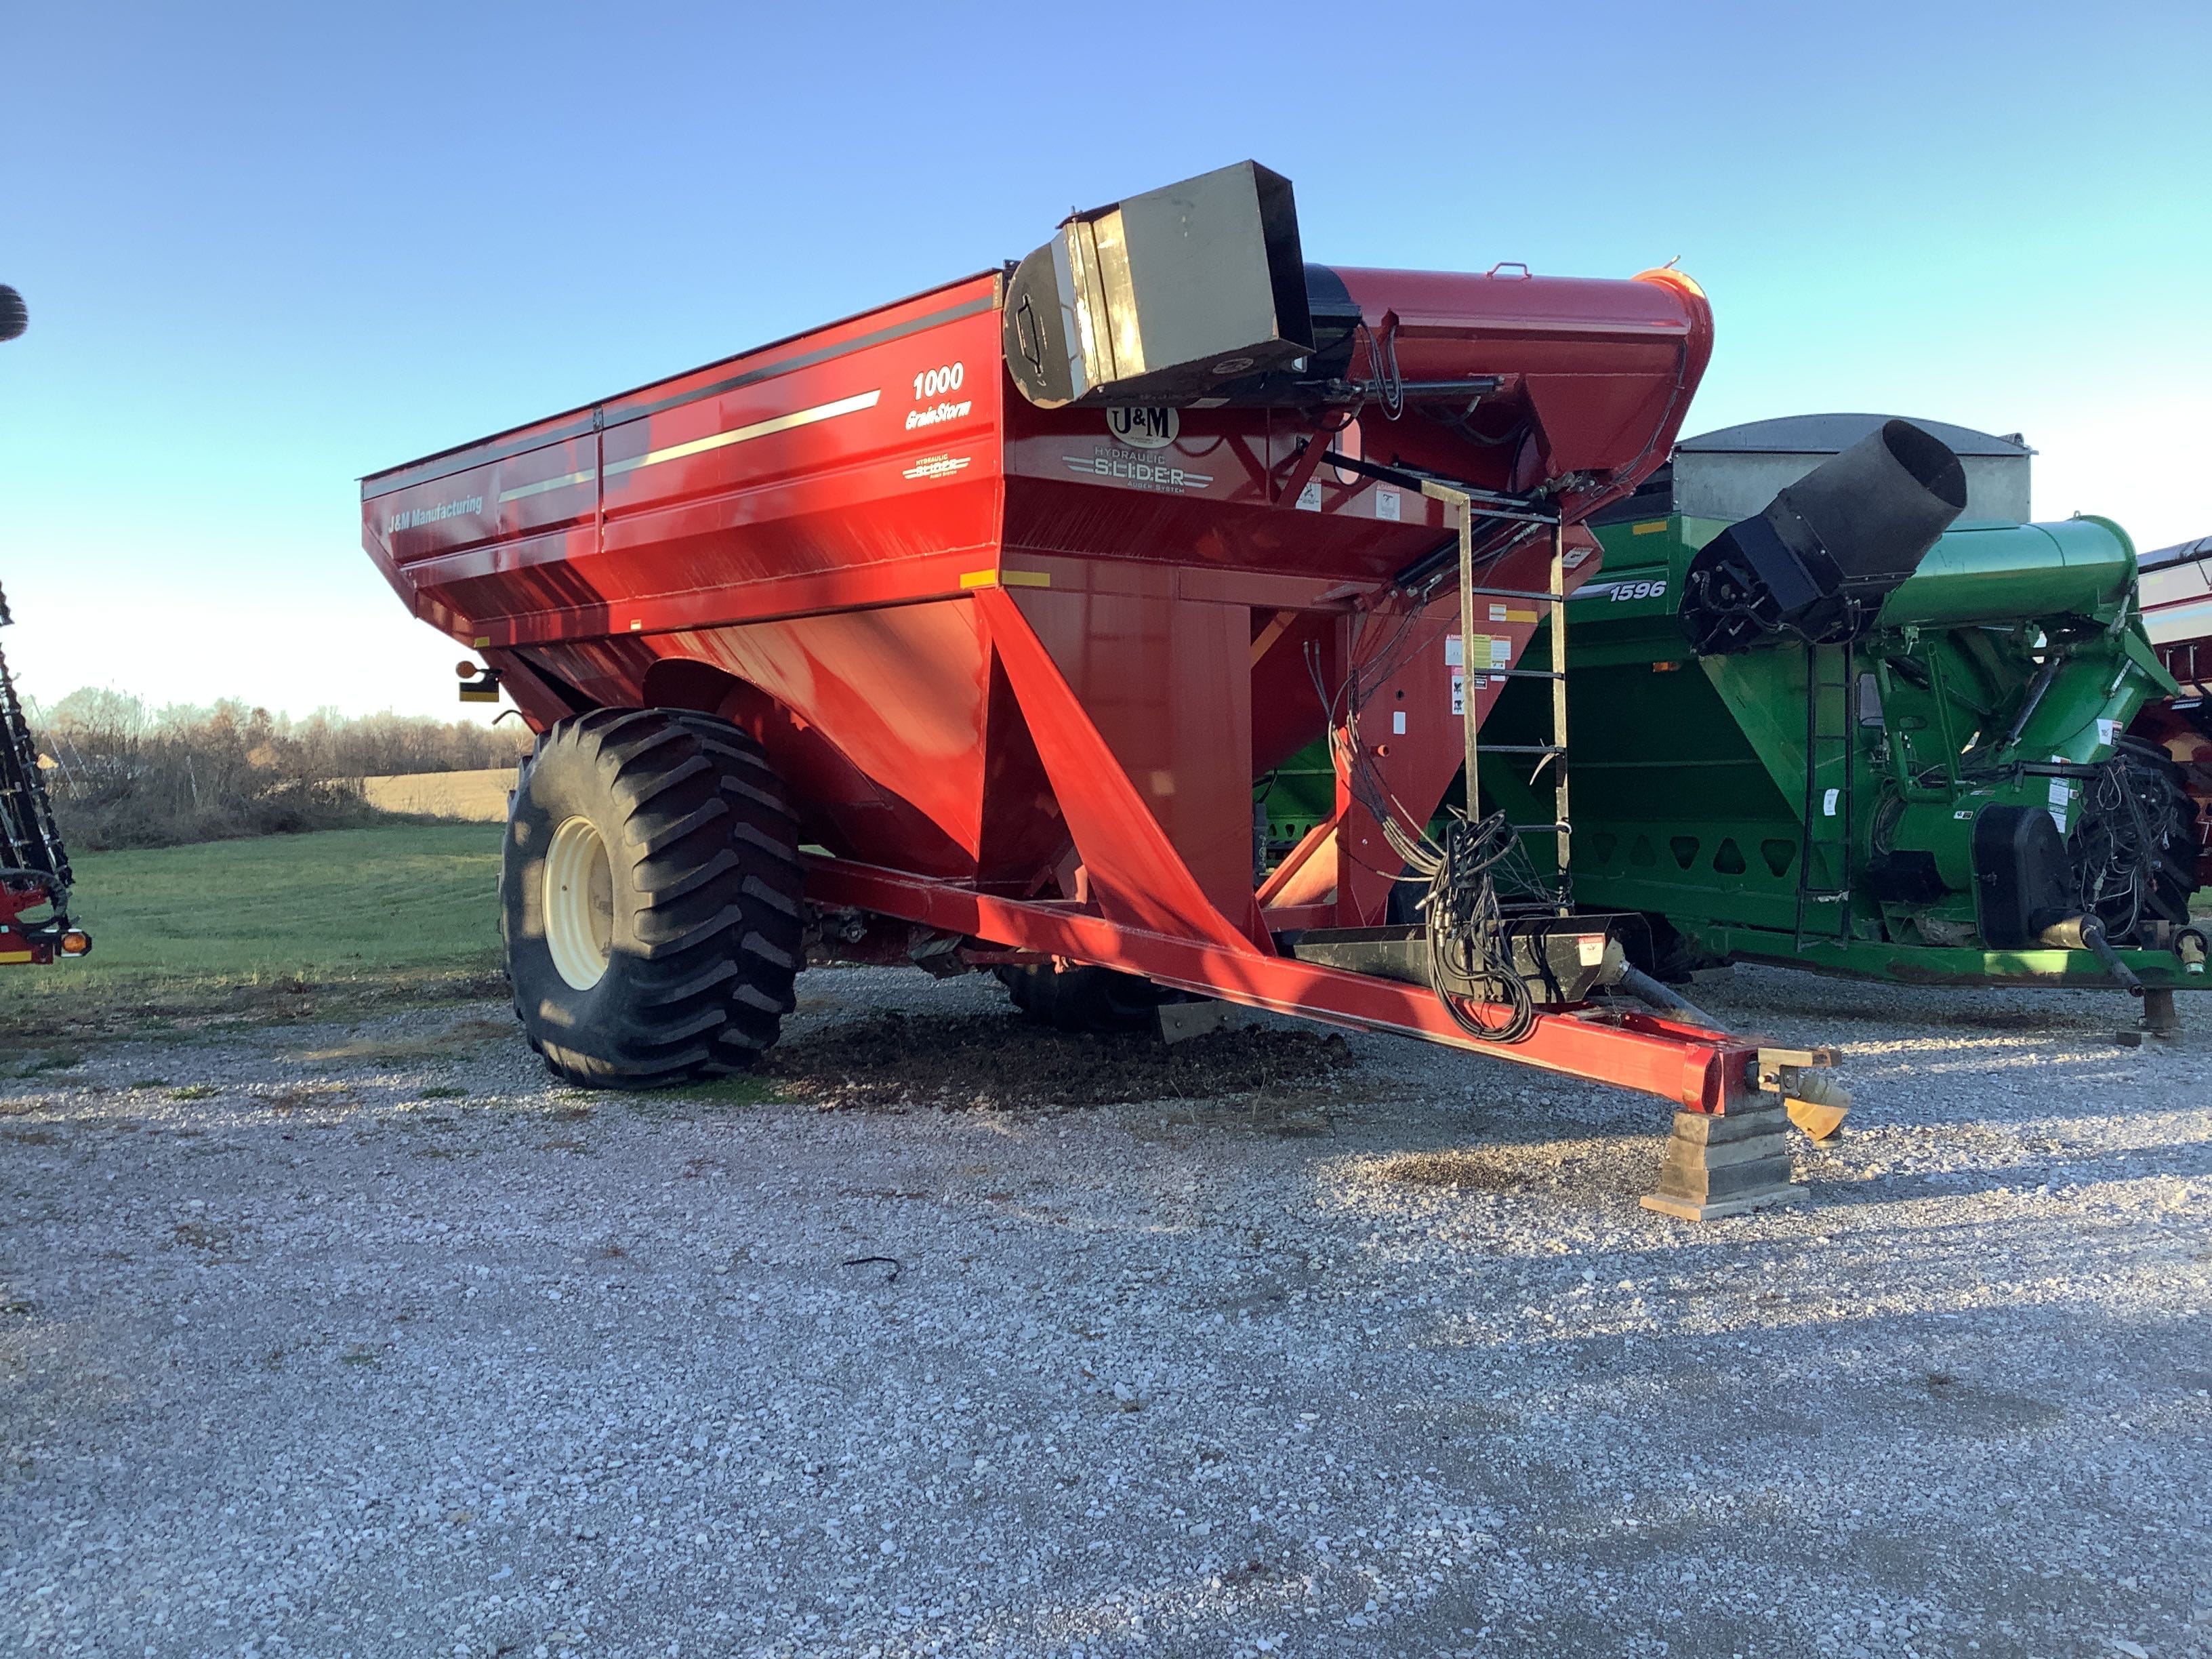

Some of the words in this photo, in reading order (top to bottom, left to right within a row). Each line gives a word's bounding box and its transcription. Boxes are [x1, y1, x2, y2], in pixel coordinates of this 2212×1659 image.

[913, 361, 964, 401] 1000
[905, 401, 972, 430] GrainStorm
[916, 453, 948, 466] HYDRAULIC
[1094, 445, 1166, 465] HYDRAULIC
[1094, 457, 1185, 485] SLIDER
[388, 511, 410, 534] J&M
[411, 495, 483, 527] Manufacturing
[1610, 580, 1668, 602] 1596
